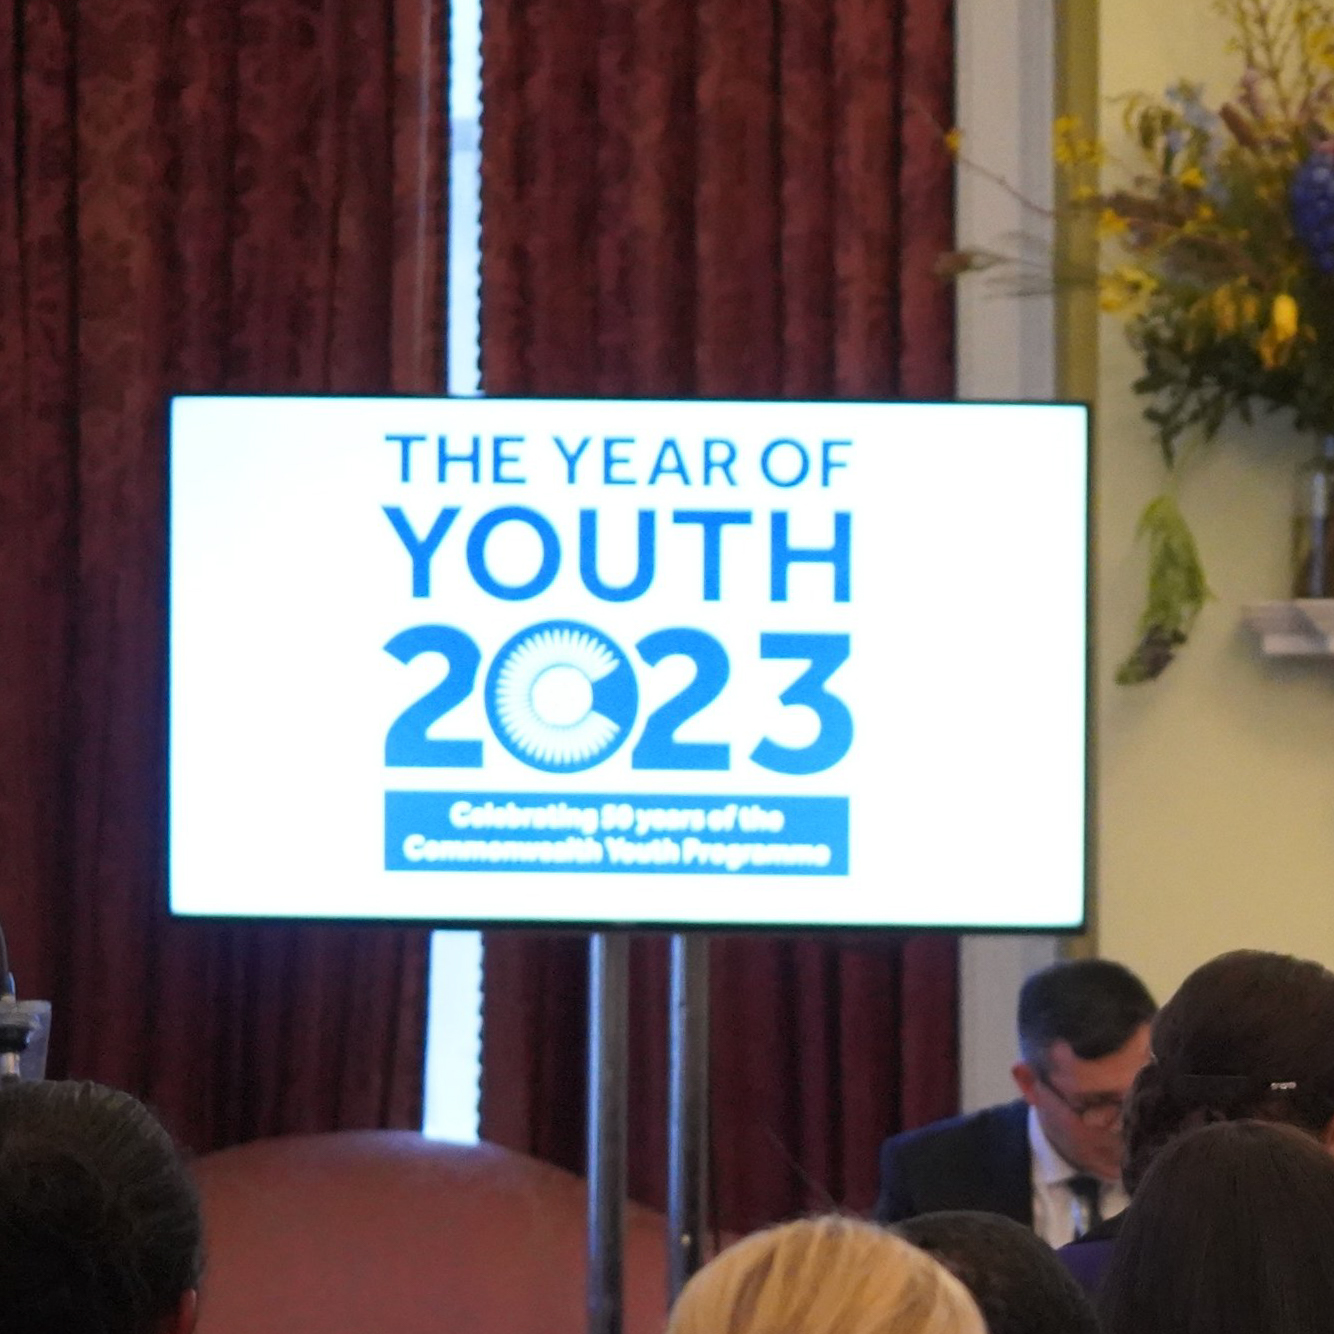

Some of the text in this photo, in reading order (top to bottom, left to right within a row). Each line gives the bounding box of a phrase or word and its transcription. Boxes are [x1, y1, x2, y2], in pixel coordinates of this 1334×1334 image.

[384, 434, 853, 489] THE YEAR OF
[382, 504, 852, 603] YOUTH
[382, 618, 854, 775] 2023
[449, 800, 598, 835] Celebrating
[635, 807, 706, 836] years
[706, 803, 738, 832] of
[738, 804, 785, 833] the
[403, 833, 831, 871] Commonwealth Youth Programme
